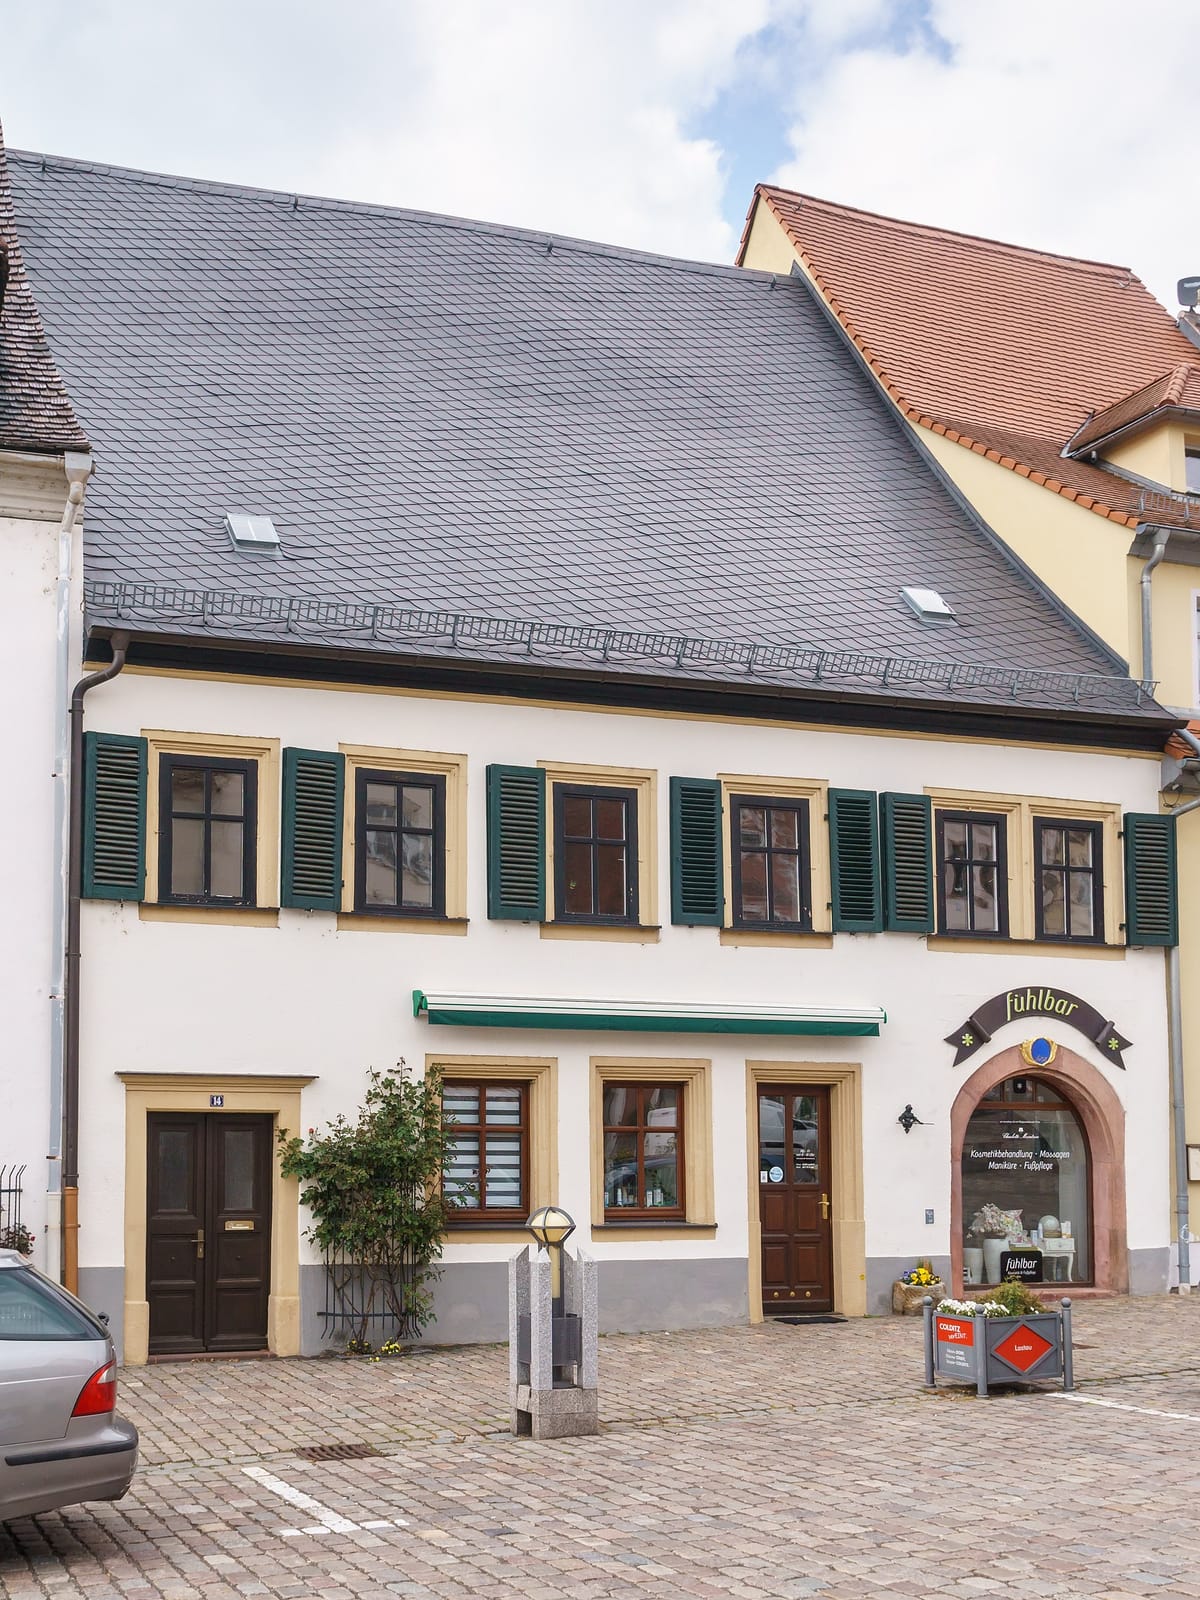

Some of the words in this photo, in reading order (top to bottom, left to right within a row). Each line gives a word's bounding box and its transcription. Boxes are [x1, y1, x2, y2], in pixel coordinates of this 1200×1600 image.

[1006, 988, 1079, 1021] fühlbar
[213, 1096, 221, 1105] 14
[970, 1149, 1033, 1160] Kosmetikbehandlung
[1039, 1150, 1070, 1159] Massagen
[988, 1161, 1018, 1170] Maniküre
[1023, 1161, 1054, 1172] Fußpflege
[1006, 1258, 1037, 1271] fühlbar
[940, 1323, 960, 1332] COLDITZ
